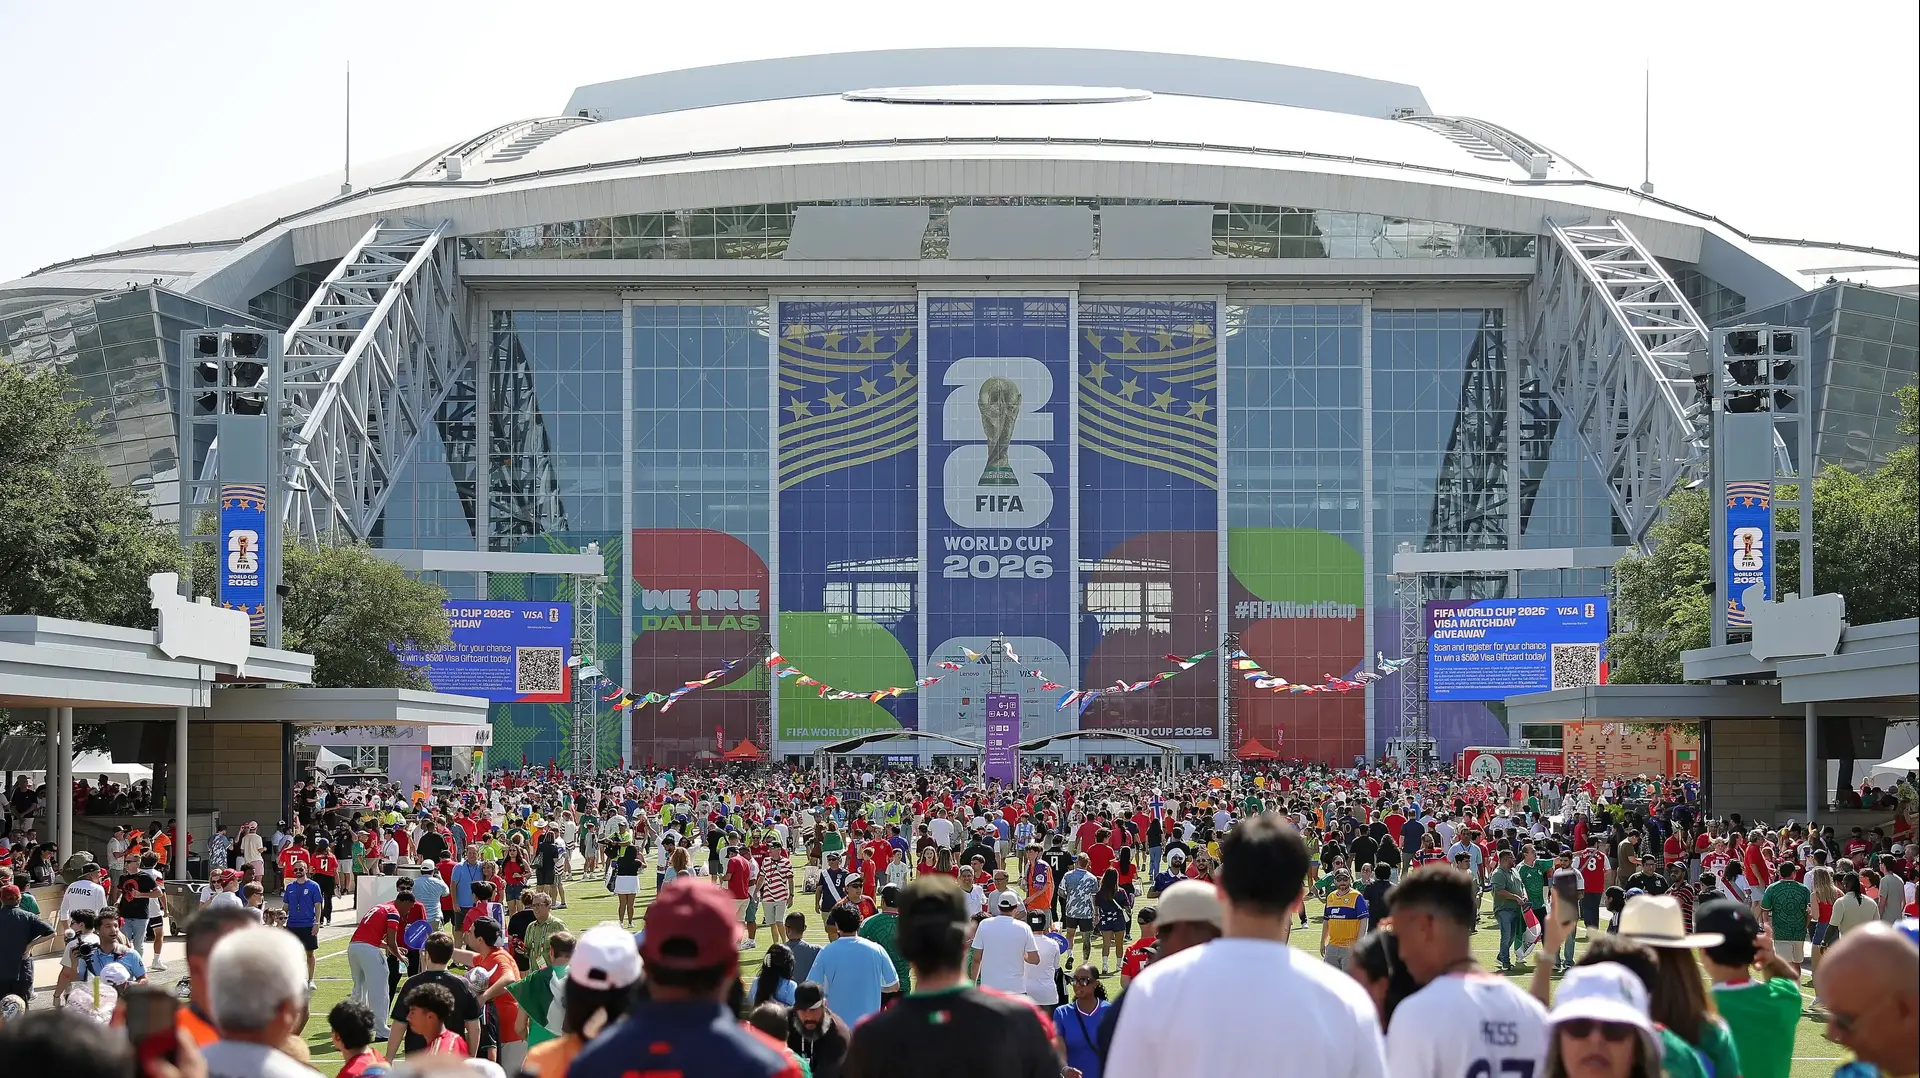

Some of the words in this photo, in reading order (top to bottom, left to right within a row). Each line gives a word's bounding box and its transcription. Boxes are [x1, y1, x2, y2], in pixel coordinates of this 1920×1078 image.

[976, 495, 1024, 512] FIFA
[944, 537, 1013, 551] WORLD
[1016, 537, 1053, 551] CUP
[943, 555, 1054, 579] 2026
[642, 589, 691, 610] WE
[697, 589, 760, 610] ARE
[461, 609, 482, 618] CUP
[522, 611, 543, 619] VISA
[1235, 601, 1357, 621] #FIFAWorldCup
[1434, 609, 1455, 618] FIFA
[1457, 608, 1494, 617] WORLD
[1495, 607, 1516, 617] CUP
[1556, 607, 1579, 615] VISA
[642, 615, 760, 631] DALLAS
[1434, 619, 1459, 628] VISA
[1460, 618, 1516, 628] MATCHDAY
[1434, 629, 1486, 639] GIVEAWAY
[458, 643, 469, 652] for
[470, 645, 485, 653] your
[486, 644, 512, 653] chance
[1434, 643, 1451, 652] Scan
[1452, 643, 1464, 651] and
[1465, 643, 1492, 653] register
[1493, 642, 1503, 651] for
[1504, 643, 1520, 652] your
[1521, 641, 1547, 651] chance
[425, 653, 443, 662] $500
[445, 654, 459, 662] Visa
[460, 654, 489, 663] Giftcard
[490, 655, 512, 664] today!
[1434, 654, 1442, 662] to
[1443, 654, 1455, 662] win
[1461, 653, 1479, 662] $500
[1480, 653, 1495, 662] Visa
[1496, 652, 1524, 661] Giftcard
[1525, 652, 1547, 662] today!
[787, 728, 808, 737] FIFA
[811, 728, 850, 737] WORLD
[852, 728, 873, 736] CUP
[1151, 727, 1173, 736] CUP
[1174, 727, 1213, 736] 2026
[1587, 857, 1597, 871] 8
[835, 878, 841, 887] 9
